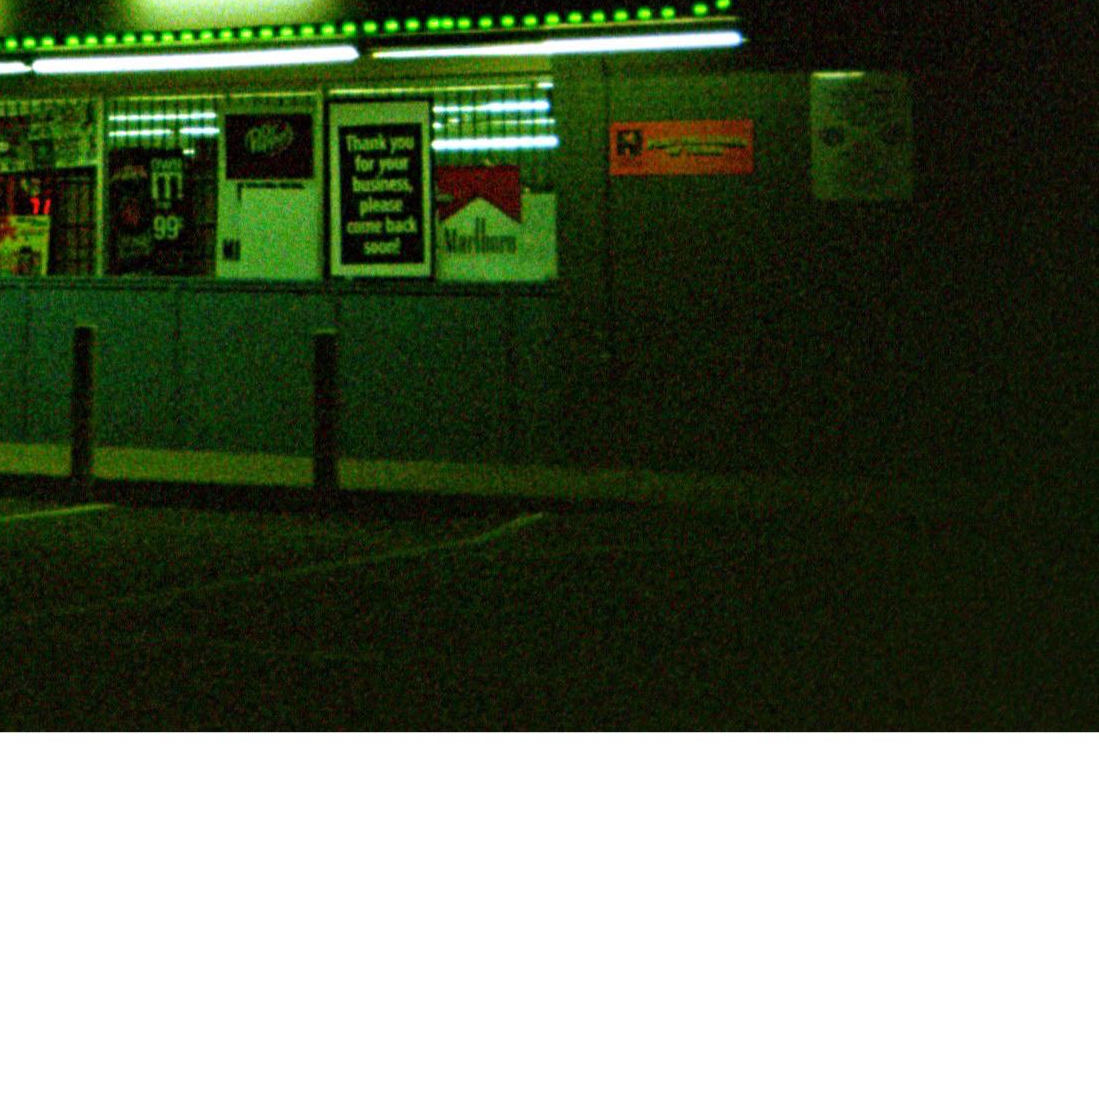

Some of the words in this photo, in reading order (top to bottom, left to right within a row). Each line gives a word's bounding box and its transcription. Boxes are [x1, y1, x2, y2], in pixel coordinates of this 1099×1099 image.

[346, 133, 387, 152] Thank
[390, 135, 415, 154] you
[355, 154, 374, 172] for
[378, 157, 409, 177] your
[385, 215, 418, 233] back
